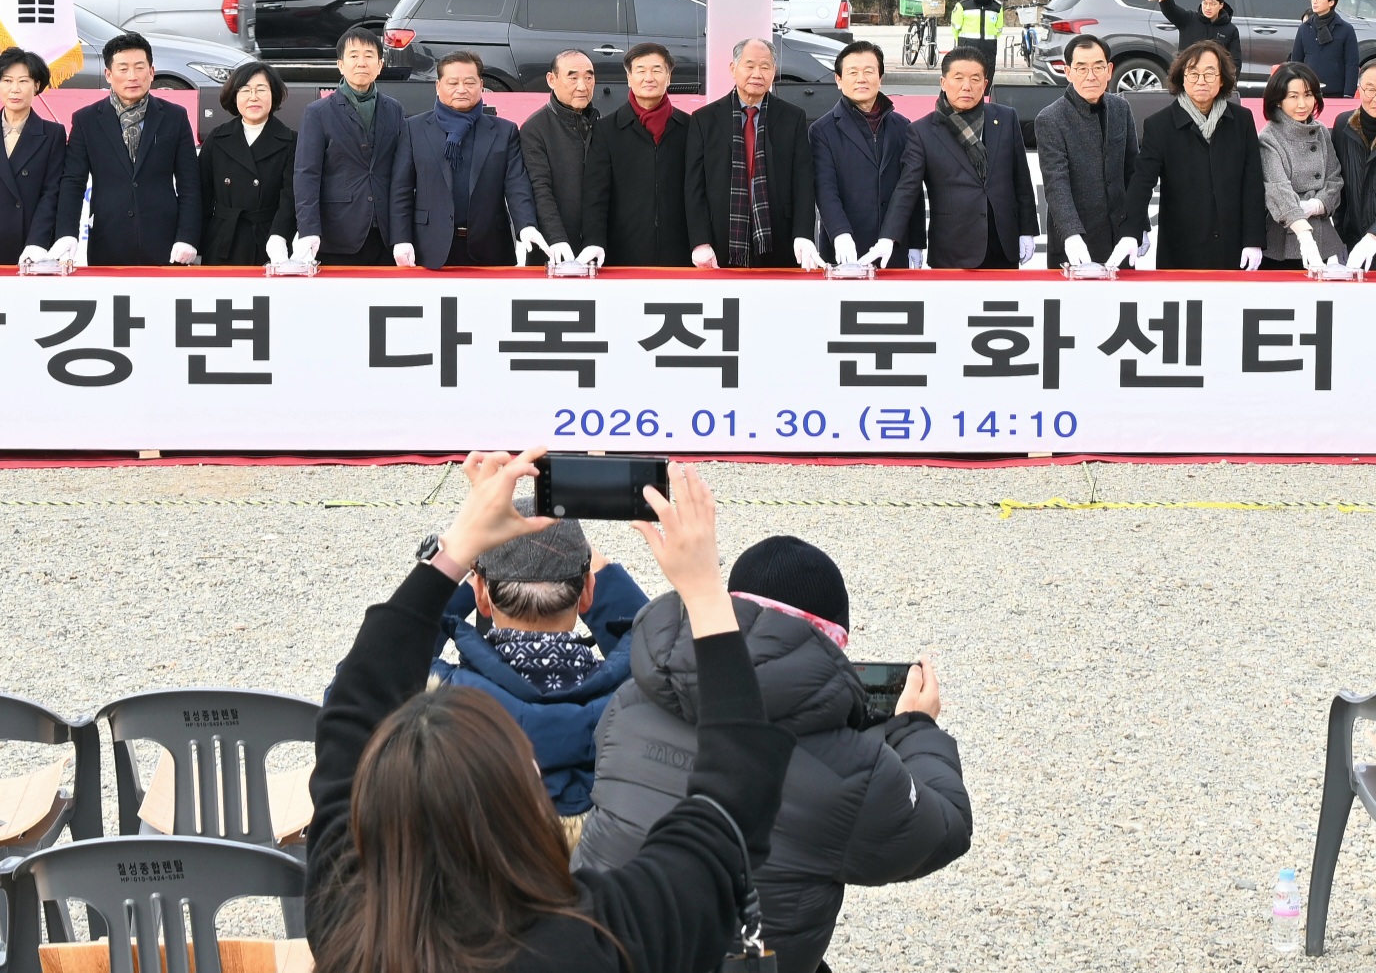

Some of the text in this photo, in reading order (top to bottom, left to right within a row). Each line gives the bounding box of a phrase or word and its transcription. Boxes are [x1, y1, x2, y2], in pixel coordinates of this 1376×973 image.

[368, 296, 740, 388] 다목적
[826, 299, 1333, 391] 문화센터
[554, 406, 1078, 441] 2026. 01. 30. (금) 14:10
[183, 709, 238, 721] 칠성종합렌탈
[118, 859, 183, 875] 칠성종합렌탈
